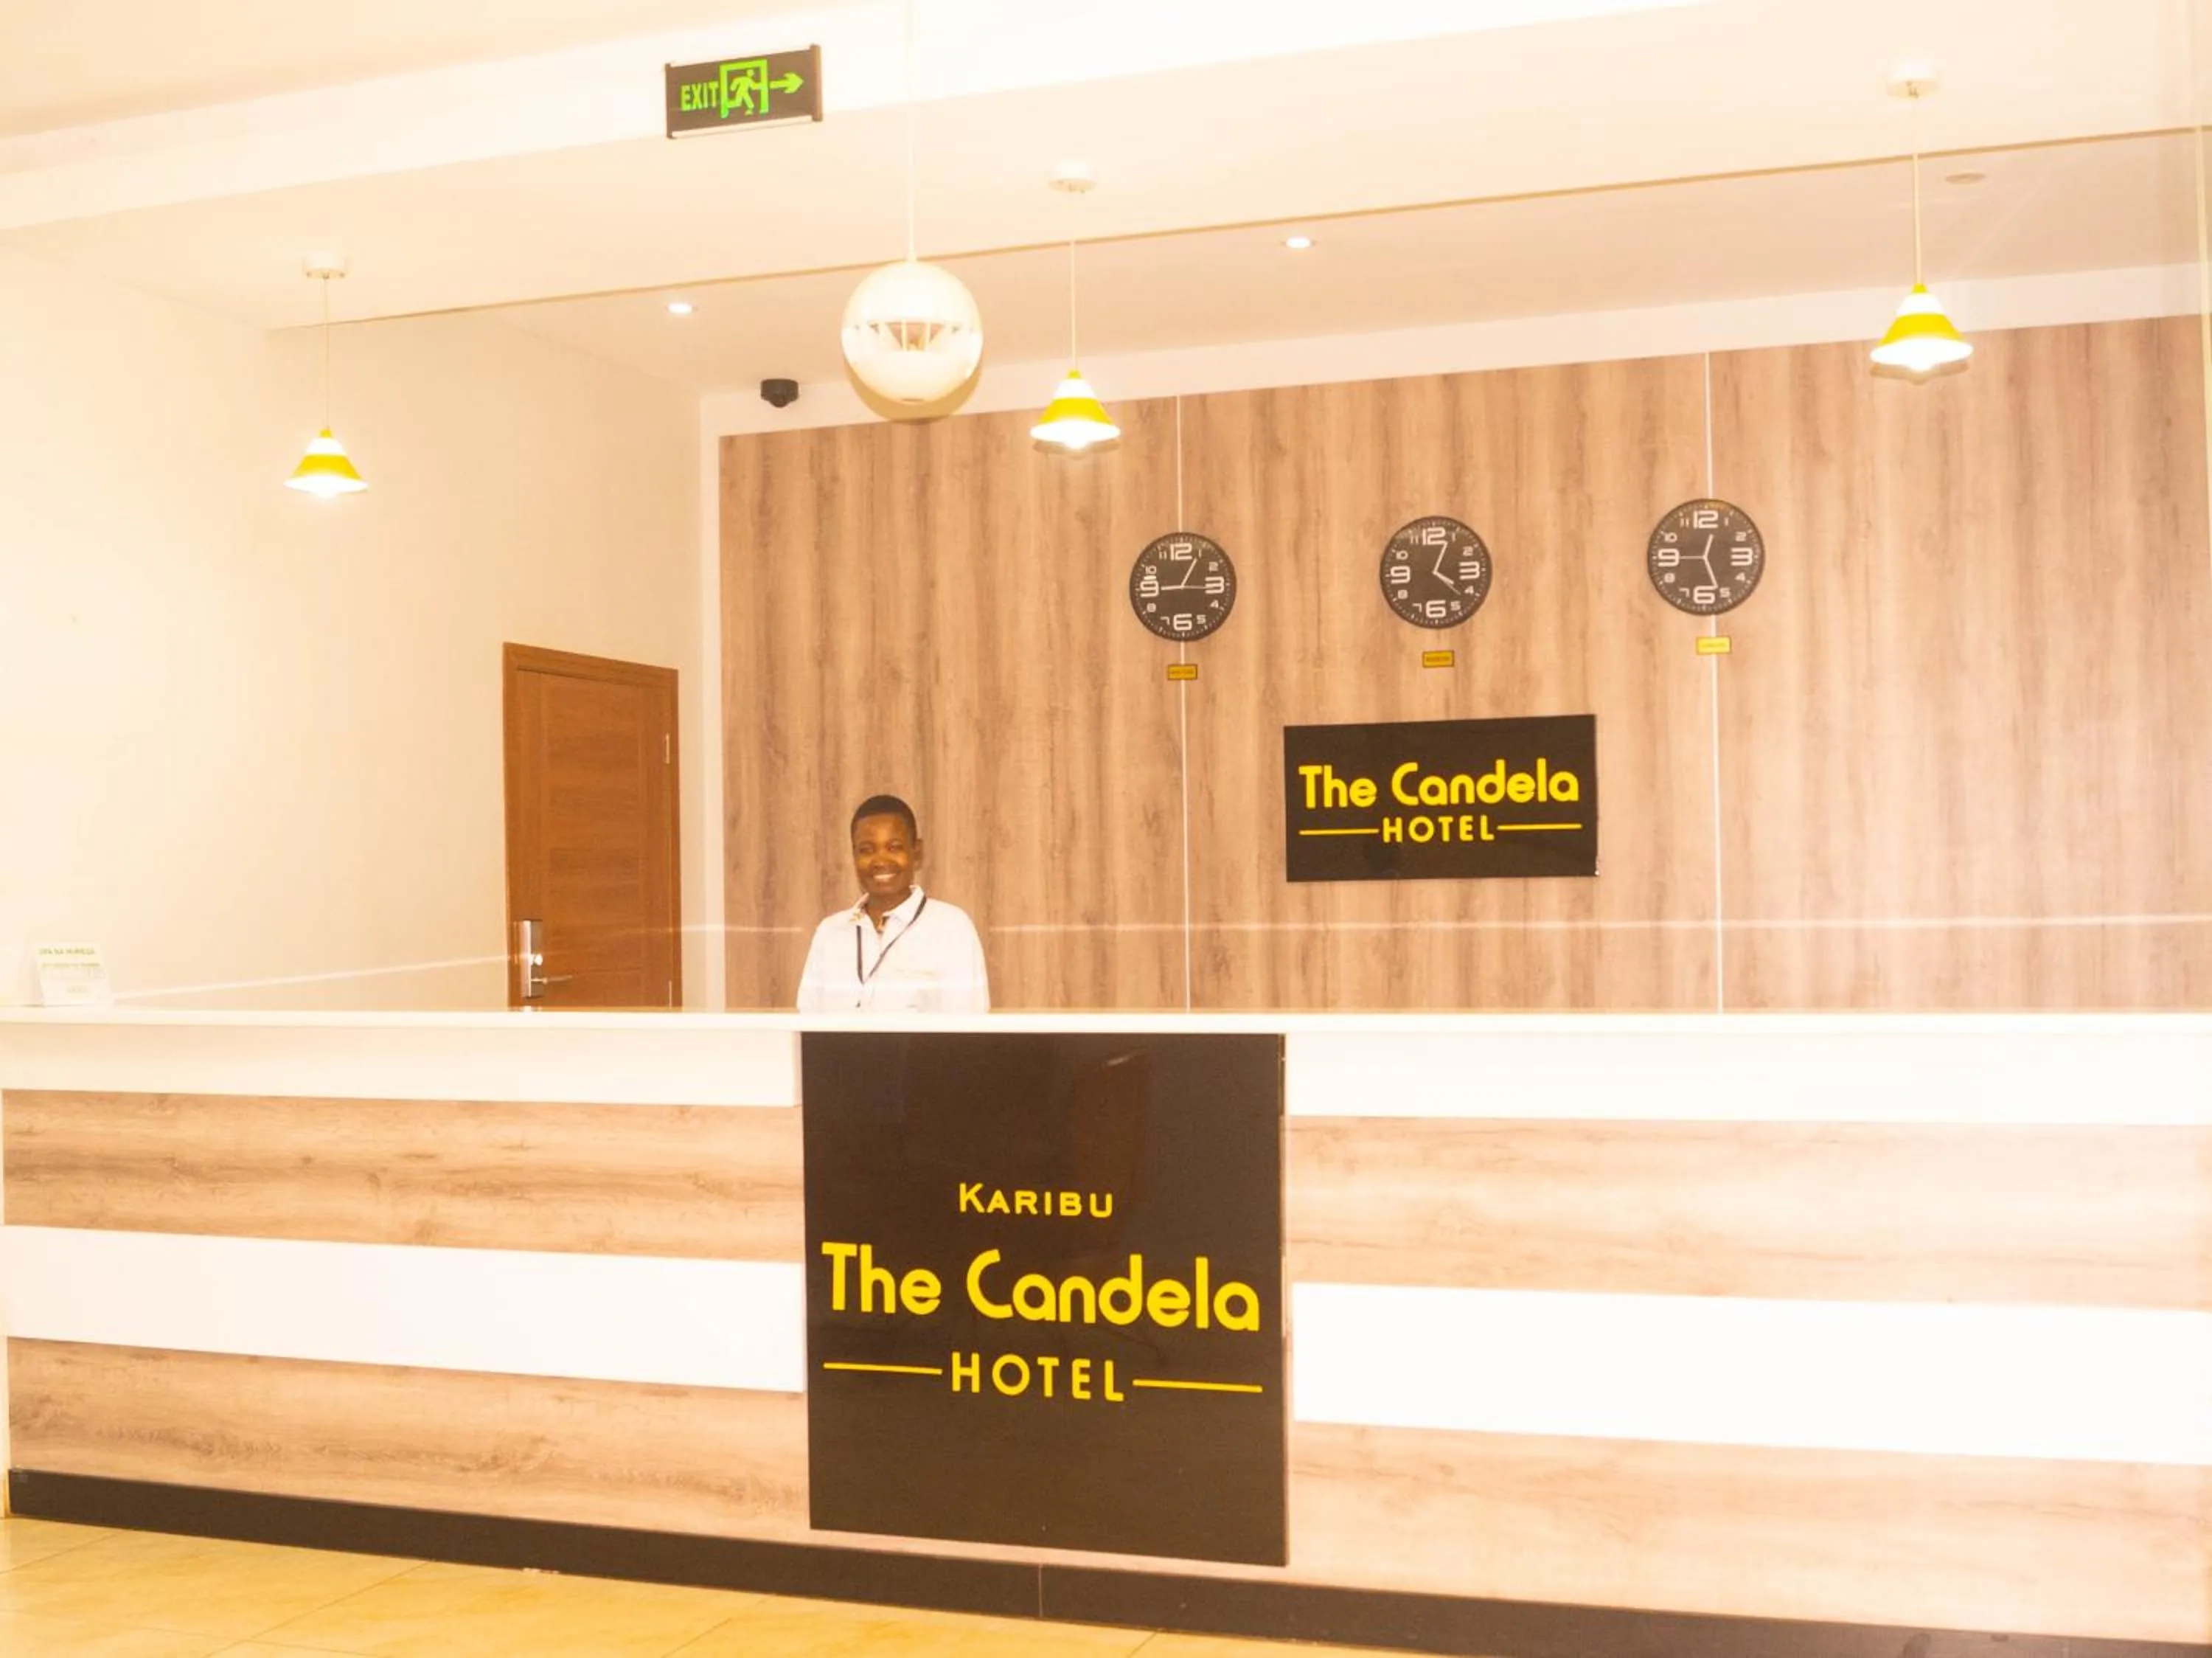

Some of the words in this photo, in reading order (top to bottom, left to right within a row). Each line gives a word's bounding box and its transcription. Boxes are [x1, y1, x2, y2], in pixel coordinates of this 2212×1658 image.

[681, 80, 719, 112] EXIT
[1680, 518, 1689, 528] 11
[1693, 510, 1719, 529] 12
[1410, 535, 1419, 545] 11
[1422, 527, 1446, 546] 12
[1664, 532, 1677, 542] 10
[1159, 551, 1166, 560] 11
[1170, 543, 1192, 561] 12
[1396, 550, 1408, 560] 10
[1658, 548, 1680, 567] 9
[1731, 547, 1753, 566] 3
[1145, 565, 1157, 575] 10
[1391, 566, 1411, 584] 9
[1459, 561, 1480, 580] 3
[1734, 572, 1746, 583] 4
[1140, 580, 1159, 597] 9
[1205, 576, 1225, 594] 3
[1464, 586, 1475, 594] 4
[1679, 588, 1689, 597] 7
[1719, 587, 1731, 598] 5
[1209, 600, 1219, 608] 4
[1694, 586, 1715, 604] 6
[1412, 603, 1422, 612] 7
[1425, 600, 1447, 618] 6
[1450, 601, 1461, 611] 5
[1160, 617, 1170, 625] 7
[1173, 613, 1192, 631] 6
[1197, 614, 1206, 625] 5
[1298, 764, 1377, 808] The
[1391, 757, 1579, 806] Candela
[1382, 814, 1495, 844] HOTEL
[959, 1182, 1113, 1218] KARIBU
[821, 1241, 942, 1315] The
[966, 1249, 1260, 1331] Candela
[951, 1351, 1124, 1402] HOTEL
